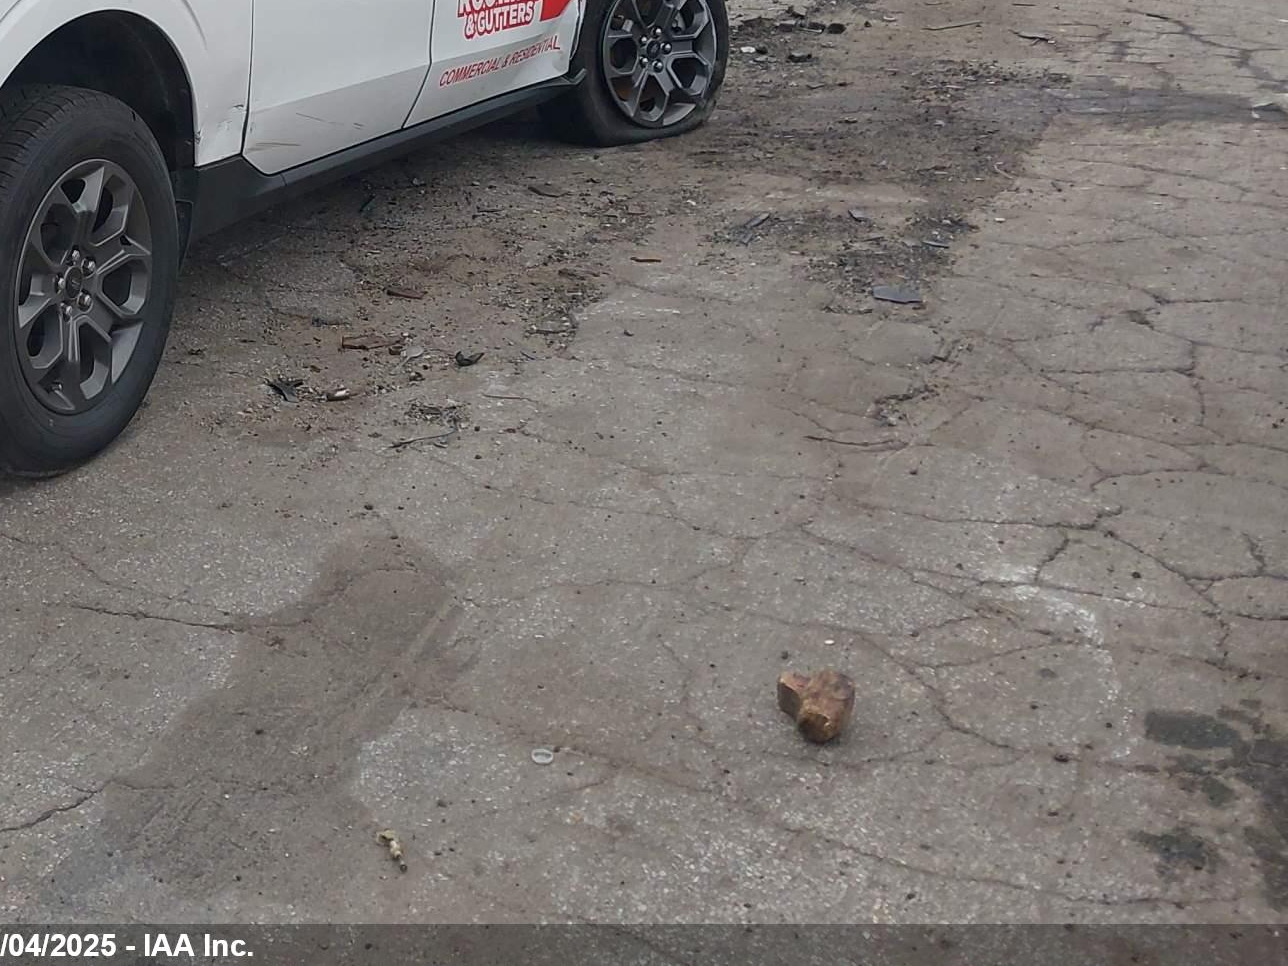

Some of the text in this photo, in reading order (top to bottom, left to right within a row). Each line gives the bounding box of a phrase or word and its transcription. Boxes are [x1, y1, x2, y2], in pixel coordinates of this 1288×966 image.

[465, 0, 535, 39] & GUTTERS
[439, 56, 502, 87] COMMERCIAL
